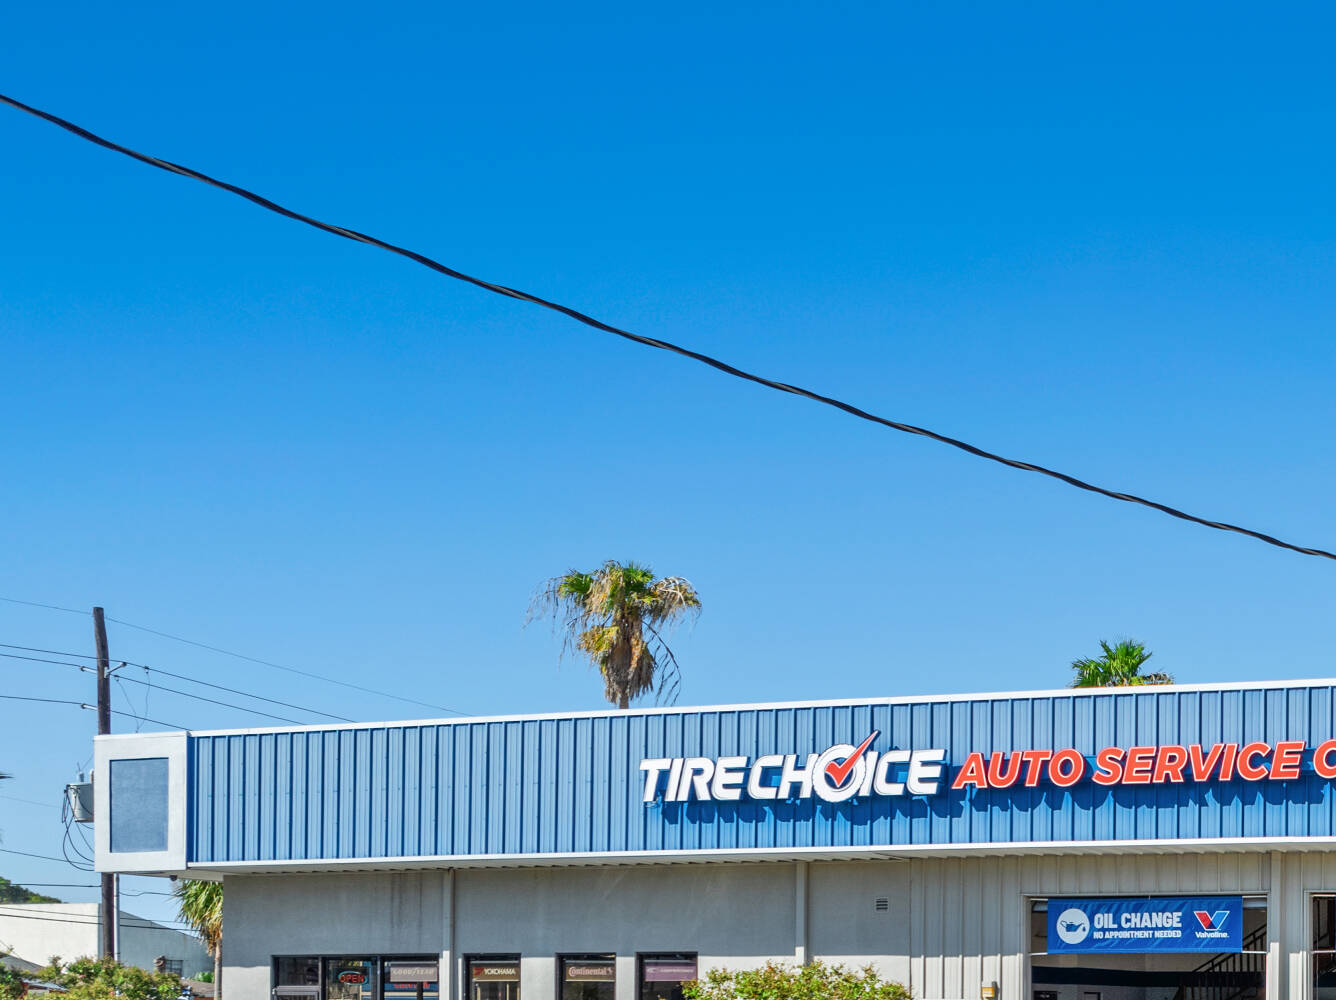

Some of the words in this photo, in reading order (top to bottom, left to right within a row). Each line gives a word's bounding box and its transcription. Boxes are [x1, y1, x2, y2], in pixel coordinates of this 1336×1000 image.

[952, 748, 1086, 790] AUTO
[1091, 740, 1306, 786] SERVICE
[1093, 913, 1118, 929] OIL
[1121, 912, 1182, 928] CHANGE
[1093, 931, 1103, 939] NO
[1105, 931, 1153, 939] APPOINTMENT
[1154, 930, 1182, 938] NEEDED
[568, 966, 607, 977] Continental
[339, 973, 365, 984] OPEN
